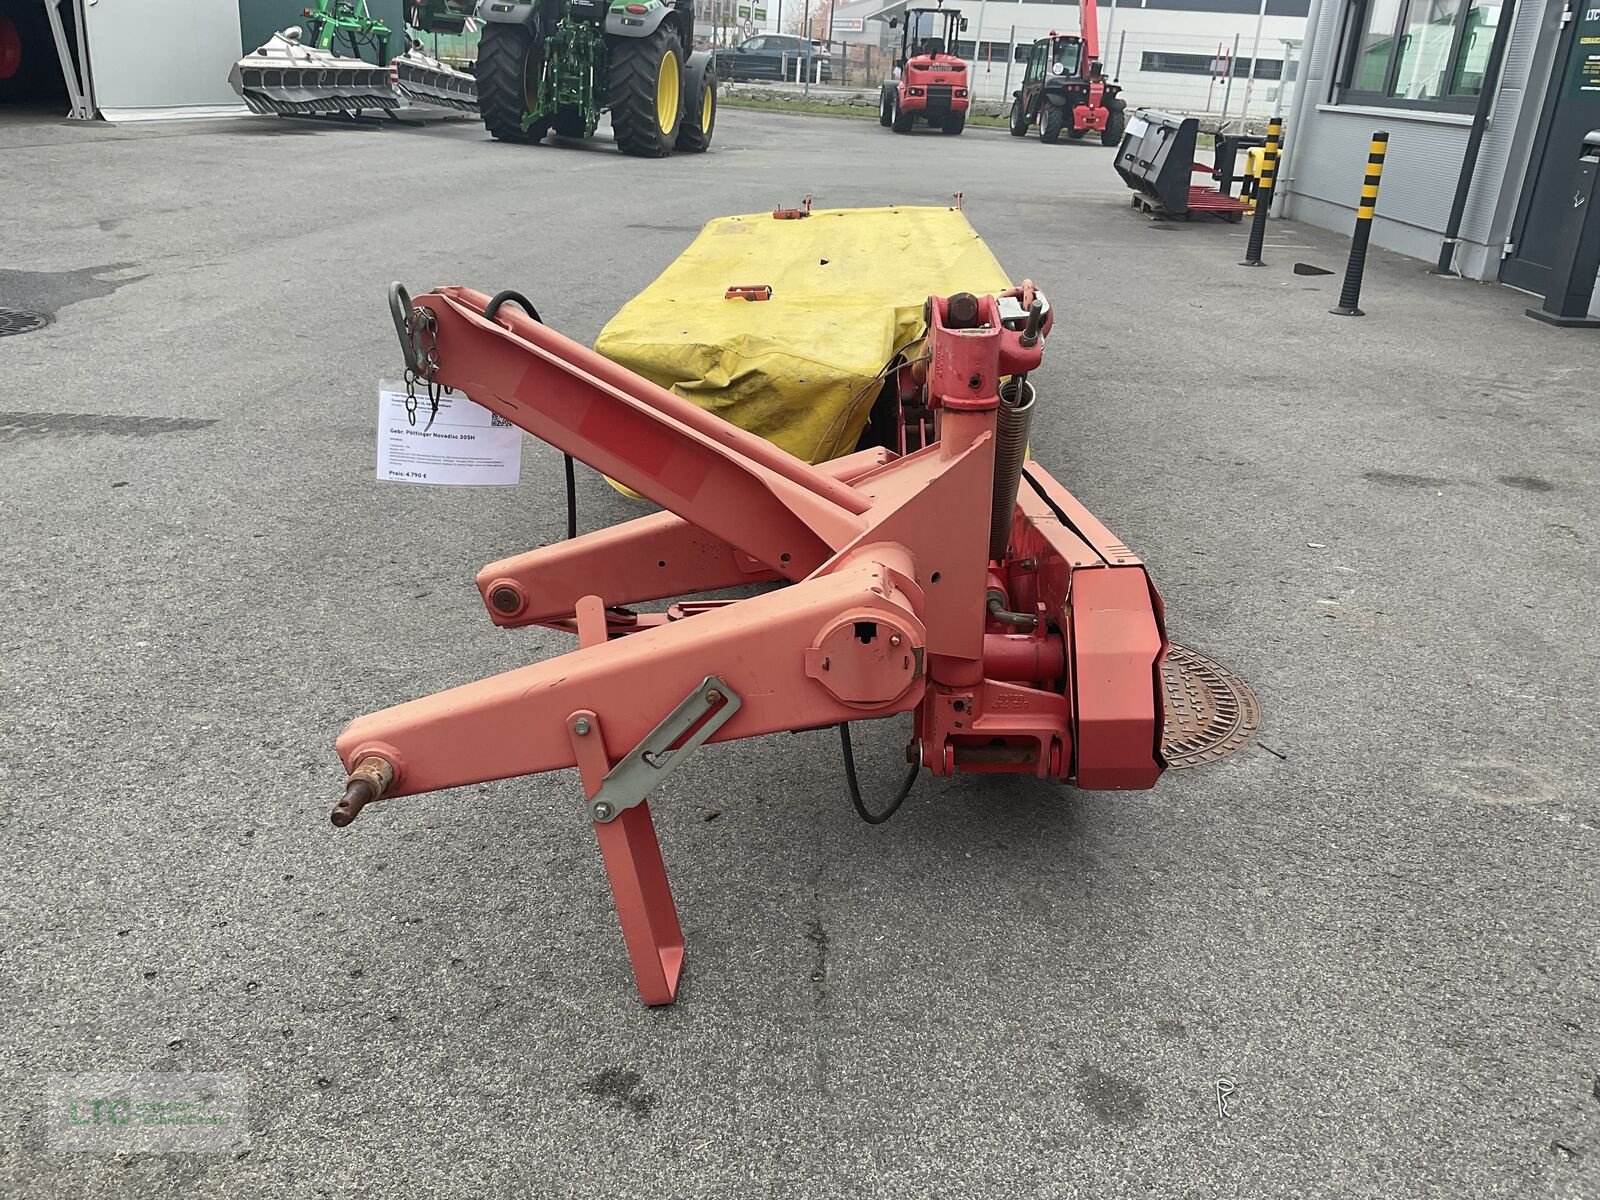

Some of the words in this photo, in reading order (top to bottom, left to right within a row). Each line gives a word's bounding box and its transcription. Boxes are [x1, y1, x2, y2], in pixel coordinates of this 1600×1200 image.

[390, 427, 406, 435] Gebr.
[406, 428, 432, 439] Pöttinger
[433, 431, 459, 440] Novadisc
[405, 471, 422, 479] 4.790
